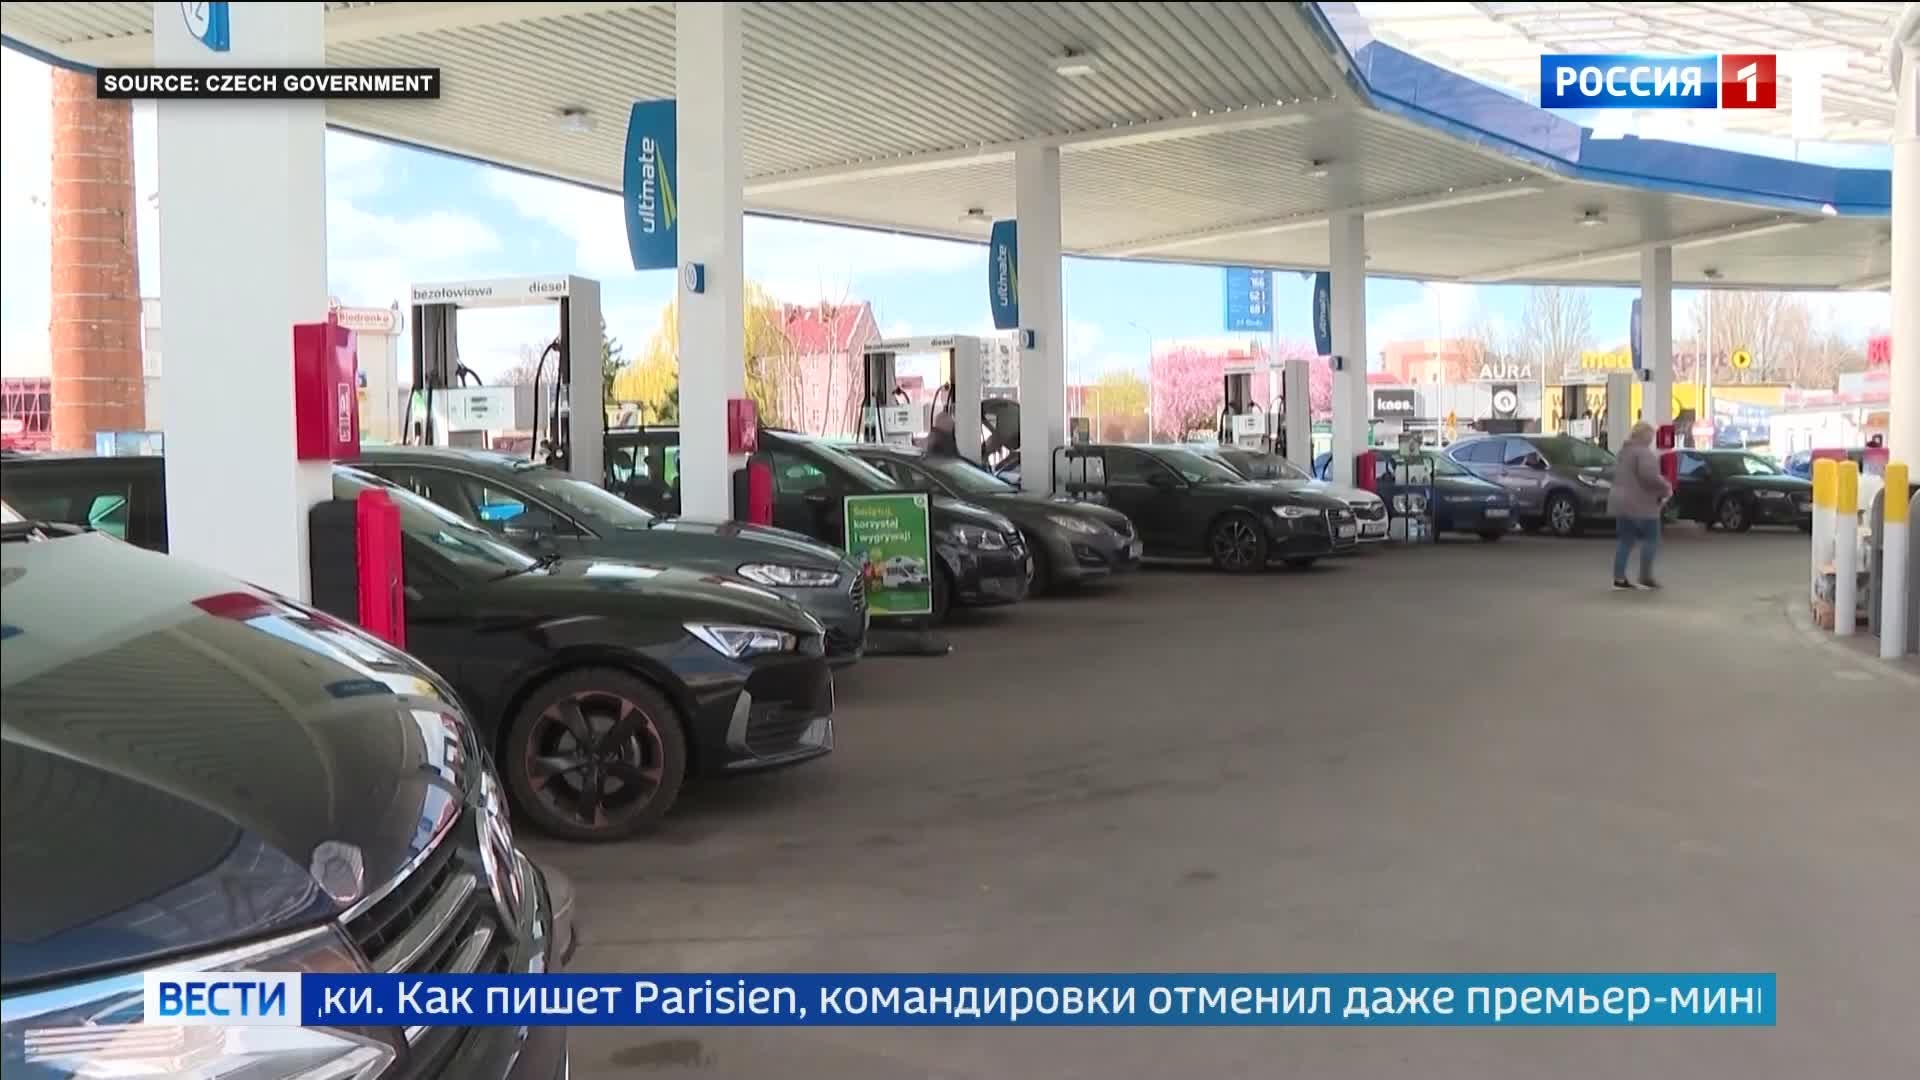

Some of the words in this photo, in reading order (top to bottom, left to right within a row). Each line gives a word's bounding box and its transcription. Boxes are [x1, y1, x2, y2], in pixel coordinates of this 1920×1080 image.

[638, 136, 656, 233] ultimate
[529, 279, 567, 294] diesel
[997, 244, 1008, 306] ultimate
[1480, 363, 1532, 379] AURA
